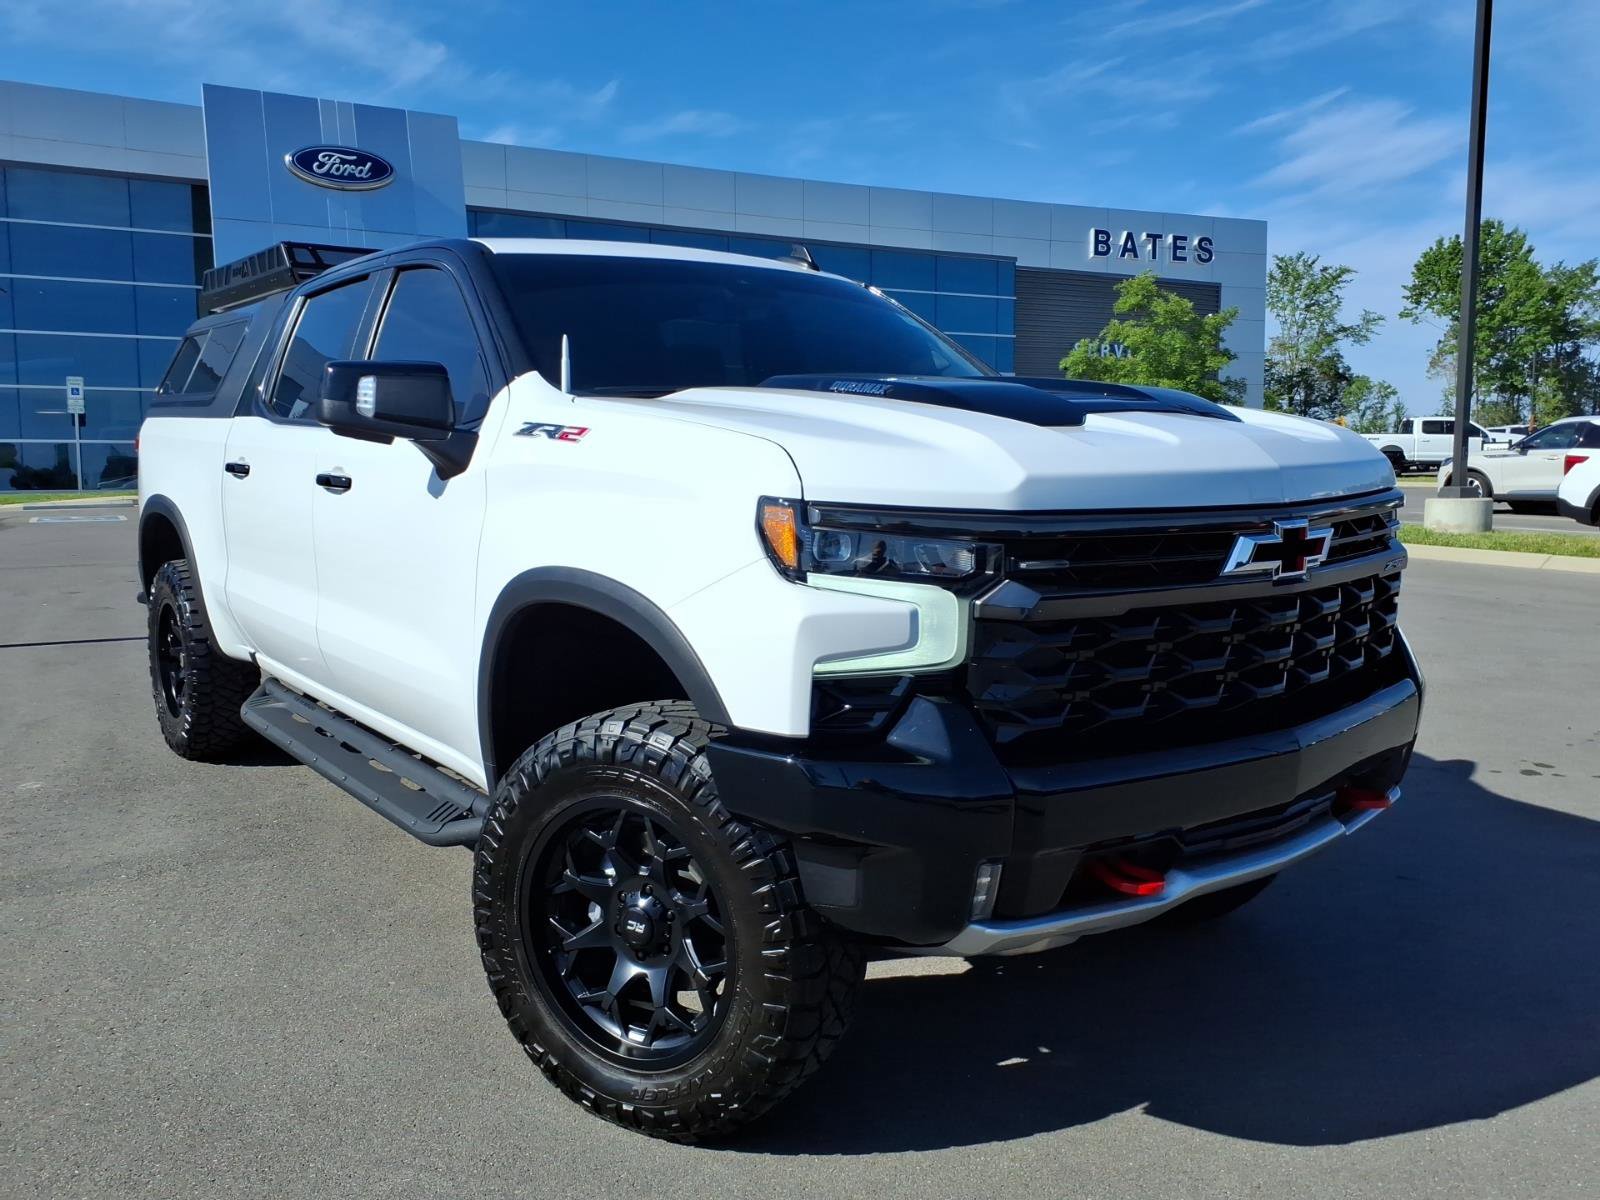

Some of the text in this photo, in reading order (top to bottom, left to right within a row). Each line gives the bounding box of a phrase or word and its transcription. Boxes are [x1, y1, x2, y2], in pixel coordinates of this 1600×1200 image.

[312, 151, 372, 178] Ford
[1089, 228, 1215, 264] BATES
[512, 421, 592, 443] ZR2
